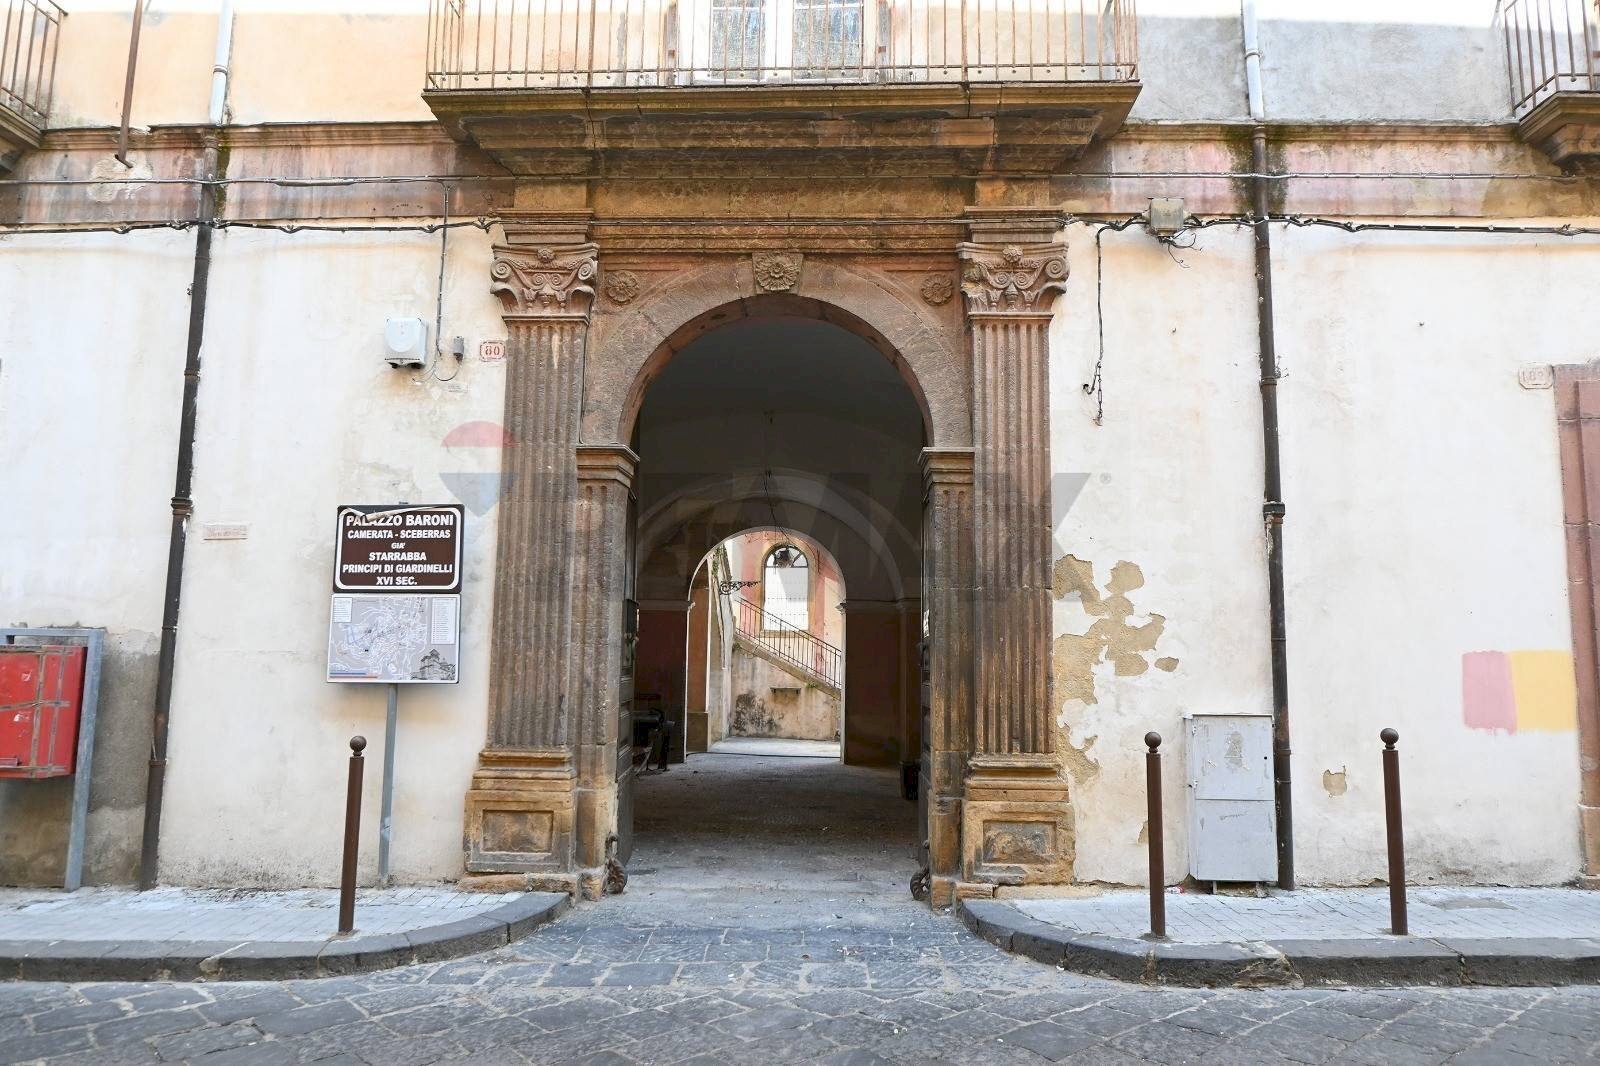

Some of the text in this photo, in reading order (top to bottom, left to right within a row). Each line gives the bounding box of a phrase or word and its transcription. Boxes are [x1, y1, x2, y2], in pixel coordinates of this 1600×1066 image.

[406, 514, 454, 526] BARONI
[348, 530, 393, 539] CAMERATA
[400, 530, 451, 539] SCEBERRAS
[369, 552, 427, 561] STARRABBA
[343, 564, 453, 573] PRINCIPI DI GIARDINELLI
[376, 577, 418, 585] XVI SEC.
